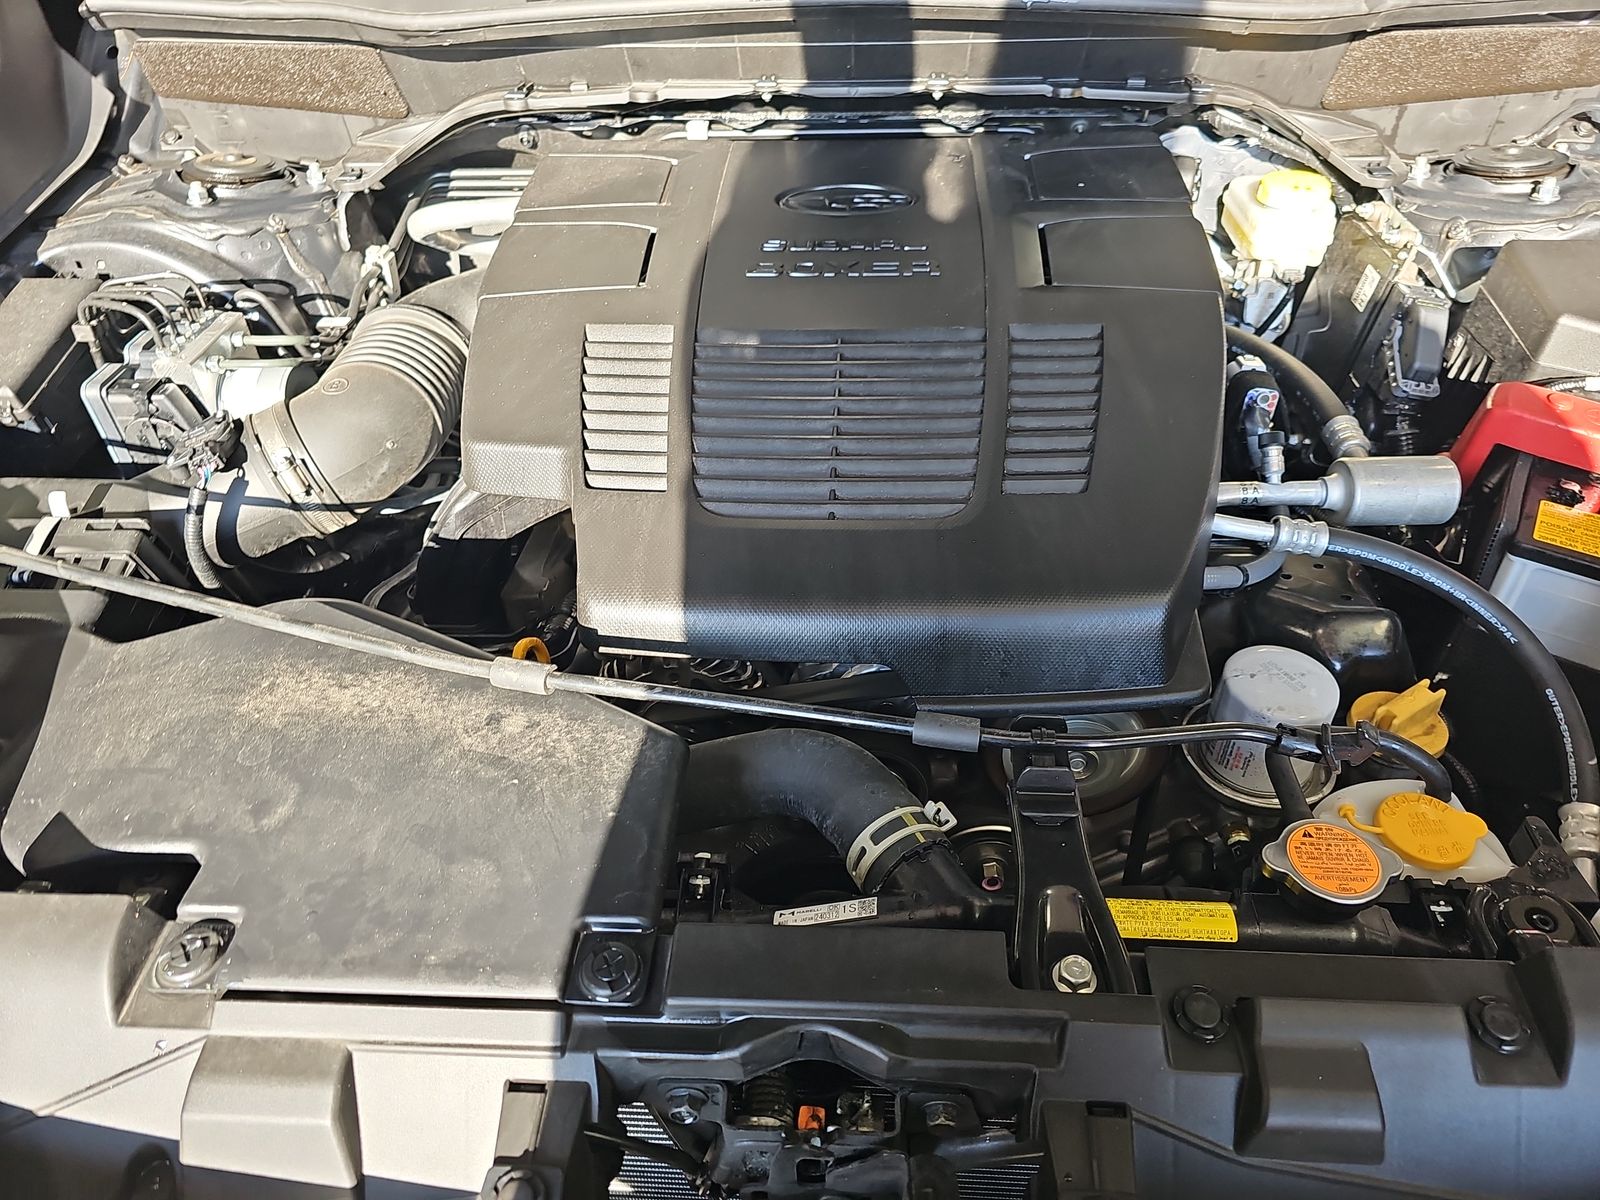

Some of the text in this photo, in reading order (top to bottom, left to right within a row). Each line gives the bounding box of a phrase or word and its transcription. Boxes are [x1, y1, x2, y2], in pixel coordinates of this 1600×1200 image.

[1540, 520, 1576, 533] POISON
[1382, 794, 1450, 818] COOLANT
[1314, 874, 1369, 883] AVERTISSEMENT
